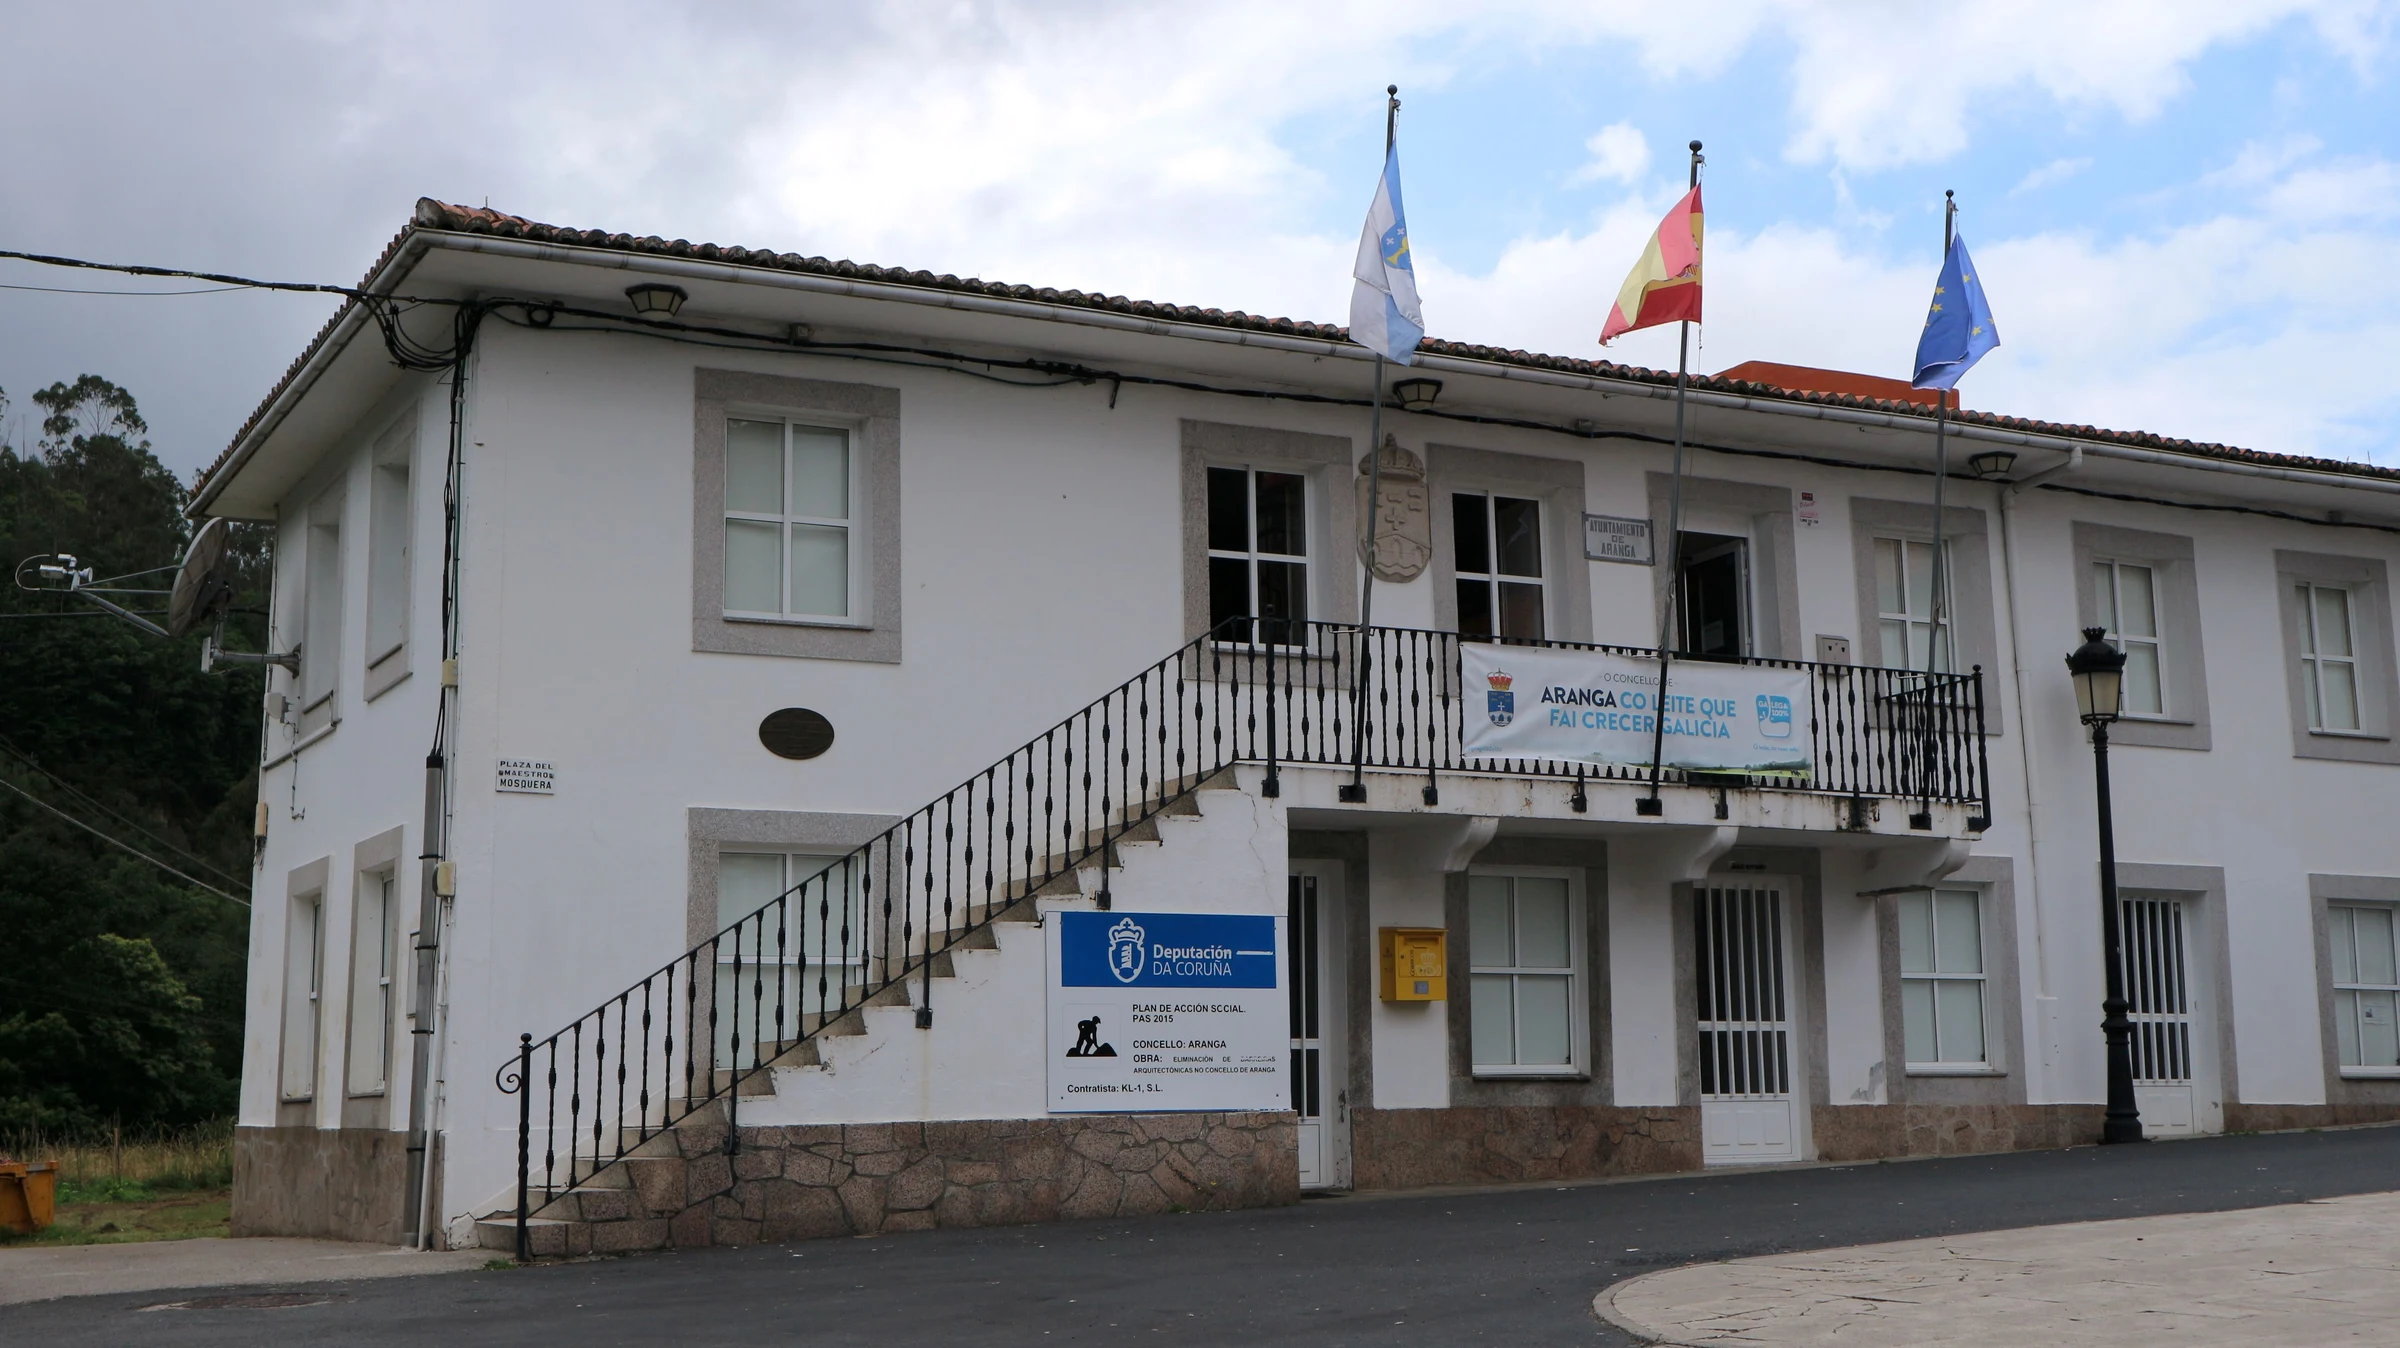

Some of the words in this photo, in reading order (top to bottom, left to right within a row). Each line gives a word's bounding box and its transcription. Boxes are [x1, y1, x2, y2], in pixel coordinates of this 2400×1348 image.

[1590, 520, 1645, 537] AYUNTAMIENTO
[1612, 535, 1624, 543] DE
[1600, 543, 1636, 558] ARANGA
[1604, 673, 1611, 682] O
[1613, 674, 1660, 686] CONCELLO
[1540, 686, 1617, 708] ARANGA
[1620, 691, 1647, 710] CO
[1652, 694, 1695, 714] LEITE
[1700, 698, 1736, 720] QUE
[1550, 709, 1576, 728] FAI
[1582, 712, 1654, 733] CRECER
[1662, 717, 1731, 739] GALICIA
[505, 770, 548, 778] MAESTRO
[500, 779, 551, 789] MOSQUERA
[1154, 944, 1232, 962] Deputación
[1154, 962, 1172, 975] DA
[1176, 960, 1232, 976] CORUÑA
[1132, 1004, 1156, 1012] PLAN
[1160, 1004, 1171, 1012] DE
[1174, 1003, 1208, 1012] ACCIÓN
[1133, 1040, 1186, 1048] CONCELLO:
[1188, 1040, 1226, 1048] ARANGA
[1133, 1054, 1162, 1062] OBRA:
[1067, 1084, 1119, 1093] Contratista:
[1122, 1084, 1144, 1093] KL-1,
[1147, 1084, 1163, 1092] S.L.
